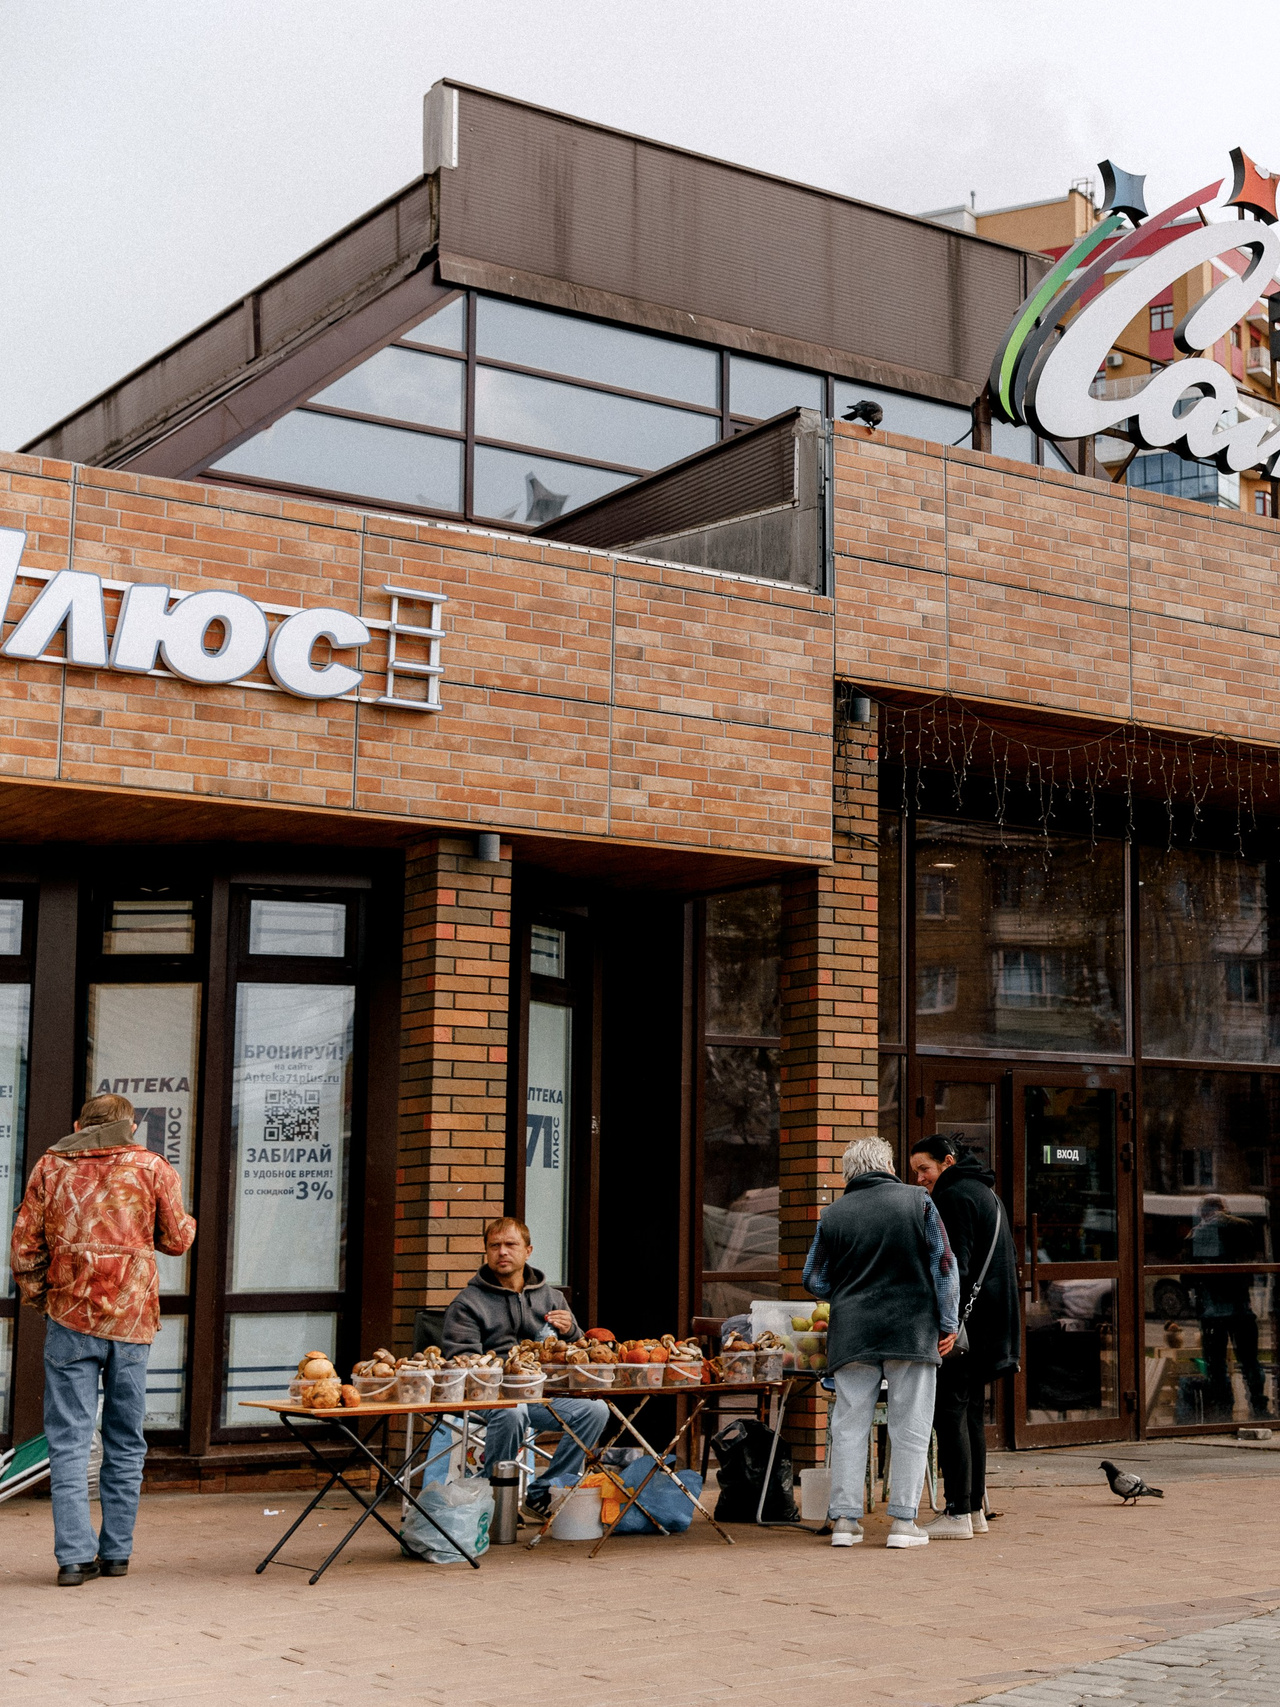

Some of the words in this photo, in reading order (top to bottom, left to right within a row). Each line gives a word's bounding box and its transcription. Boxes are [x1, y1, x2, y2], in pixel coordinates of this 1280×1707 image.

[244, 1042, 344, 1060] БРОНИРУЙ!
[287, 1062, 313, 1071] сайте
[96, 1077, 190, 1094] АПТЕКА
[244, 1072, 340, 1083] Apteka71plus.ru
[167, 1107, 182, 1165] ПЛЮС
[552, 1117, 560, 1169] ПЛЮС
[246, 1144, 332, 1163] ЗАБИРАЙ
[1056, 1149, 1080, 1161] ВХОД
[244, 1170, 250, 1178] В
[253, 1170, 297, 1179] УДОБНОЕ
[299, 1169, 333, 1178] ВРЕМЯ!
[256, 1187, 294, 1195] скидкой
[296, 1181, 334, 1200] 3%
